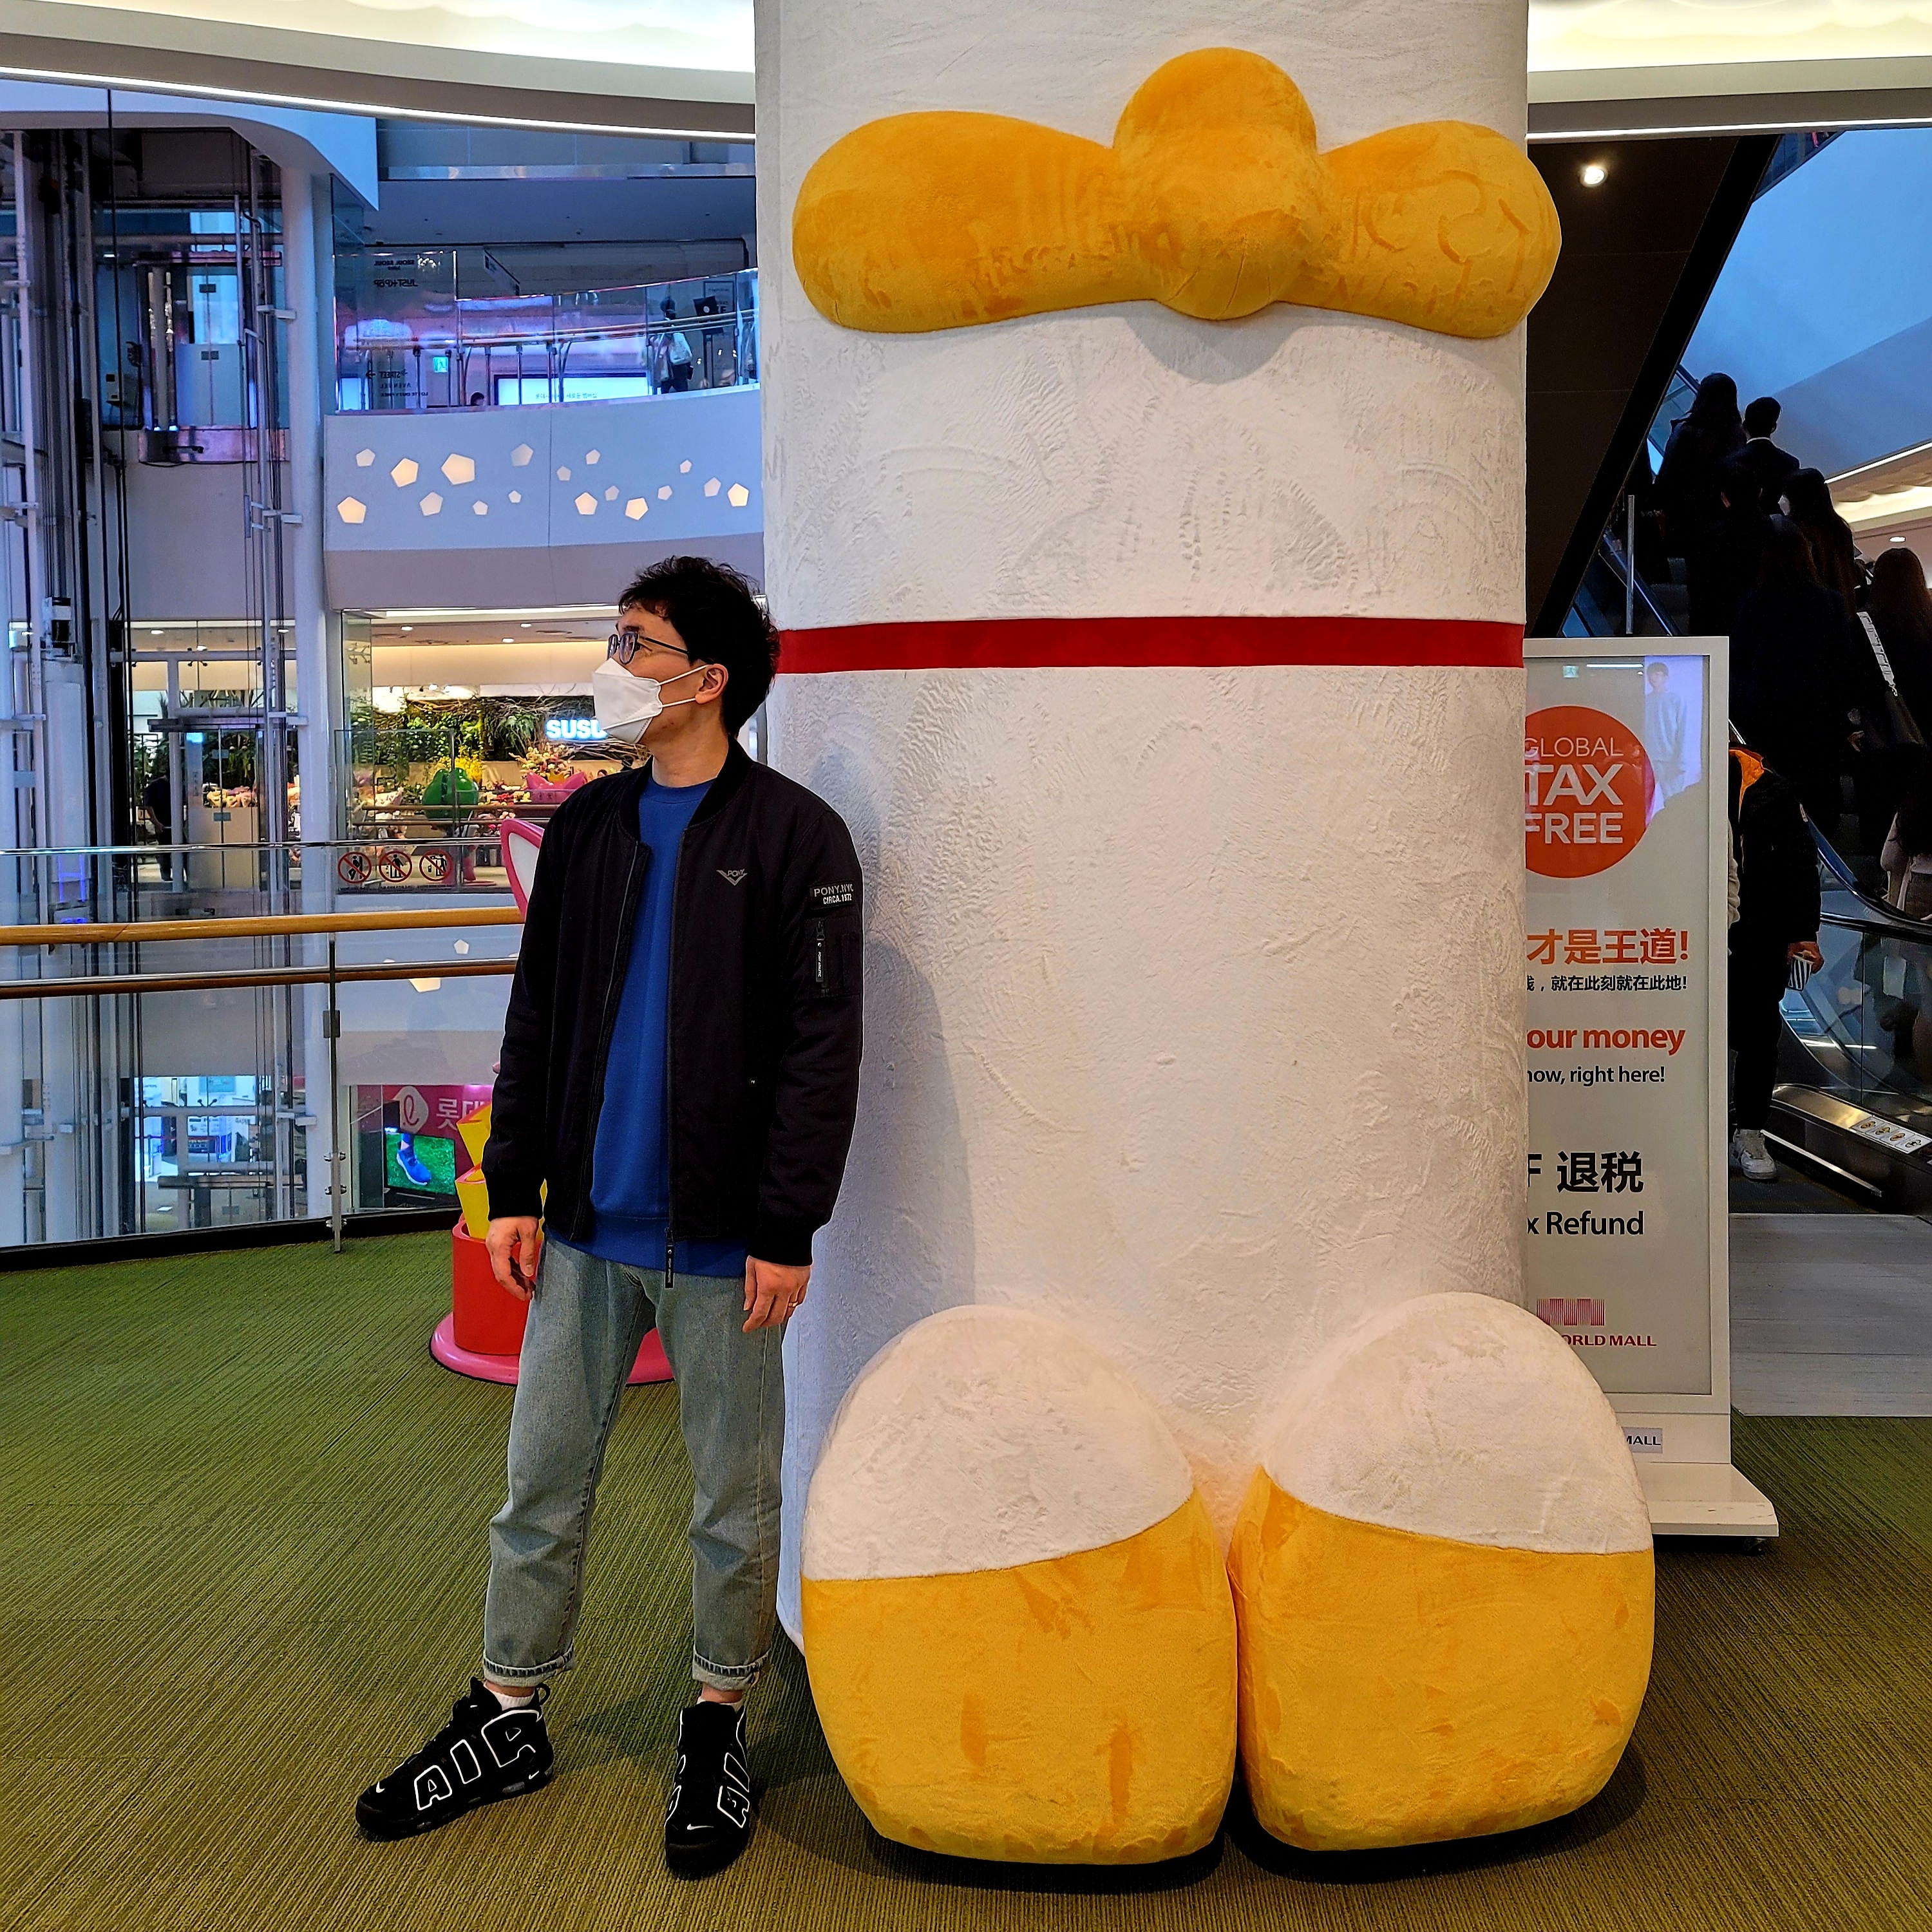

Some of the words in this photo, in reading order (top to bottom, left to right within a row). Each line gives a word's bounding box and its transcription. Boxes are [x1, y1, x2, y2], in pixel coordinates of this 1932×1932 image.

[1524, 737, 1624, 757] GLOBAL
[1524, 764, 1624, 806] TAX
[813, 884, 854, 897] PONY.NYC
[1526, 927, 1689, 965] 才是王道!
[1526, 1030, 1578, 1049] our
[1583, 1029, 1687, 1056] money
[1569, 1065, 1615, 1086] right
[1618, 1065, 1665, 1083] here!
[1557, 1150, 1644, 1193] 退税
[1546, 1210, 1644, 1235] Refund
[1561, 1334, 1606, 1346] ORLD
[1609, 1335, 1657, 1347] MALL
